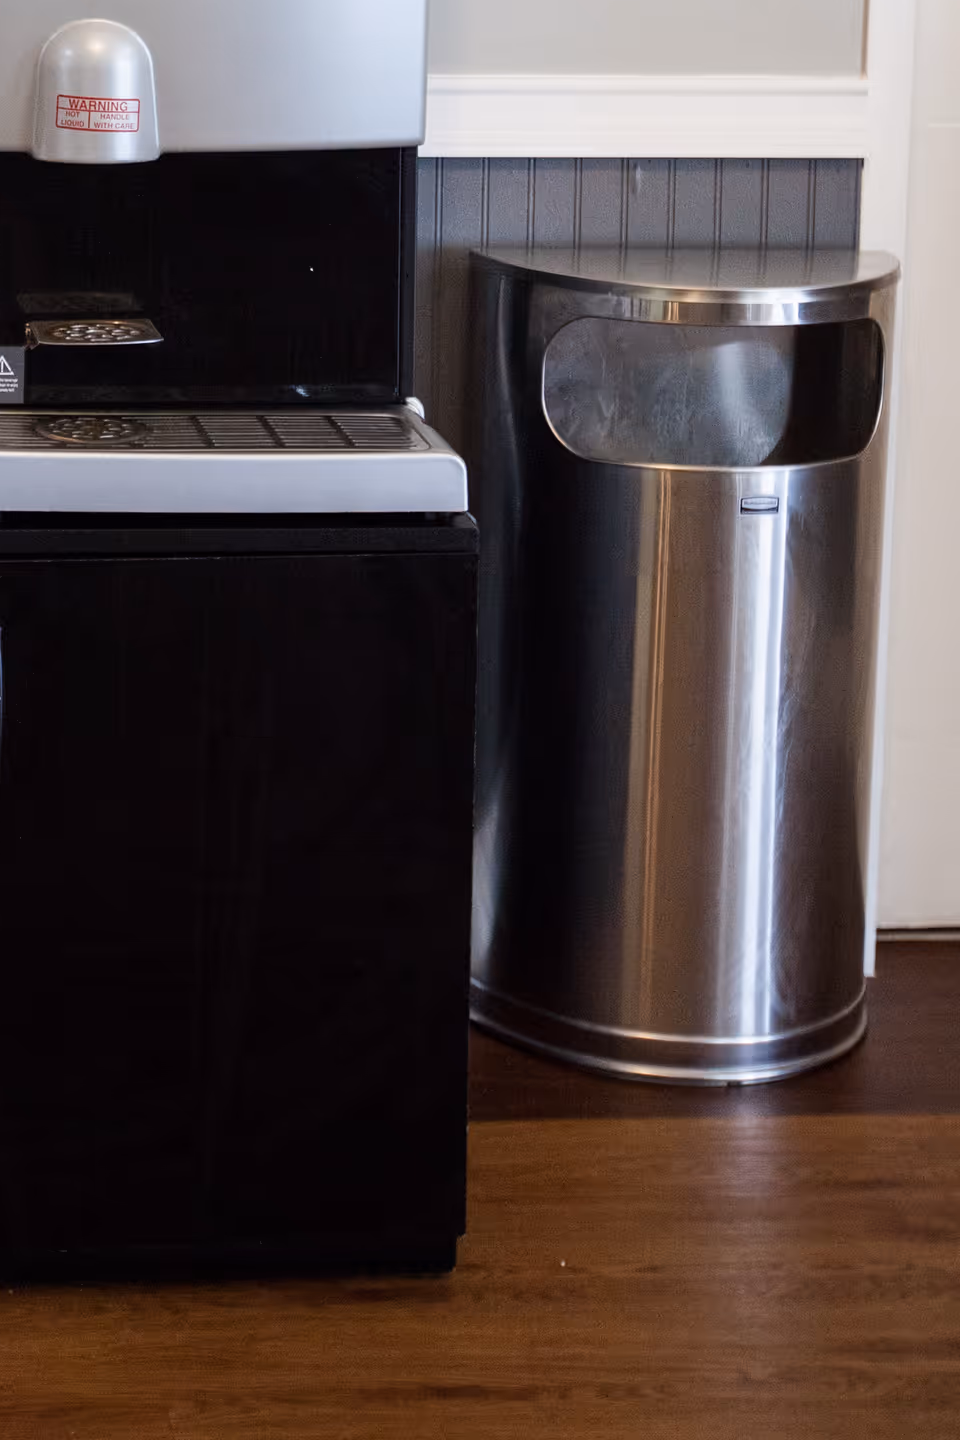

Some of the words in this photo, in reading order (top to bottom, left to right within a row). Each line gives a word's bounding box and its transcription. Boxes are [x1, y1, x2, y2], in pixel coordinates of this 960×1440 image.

[69, 99, 128, 112] WARNING
[65, 110, 81, 118] HOT
[60, 119, 85, 128] LIQUID
